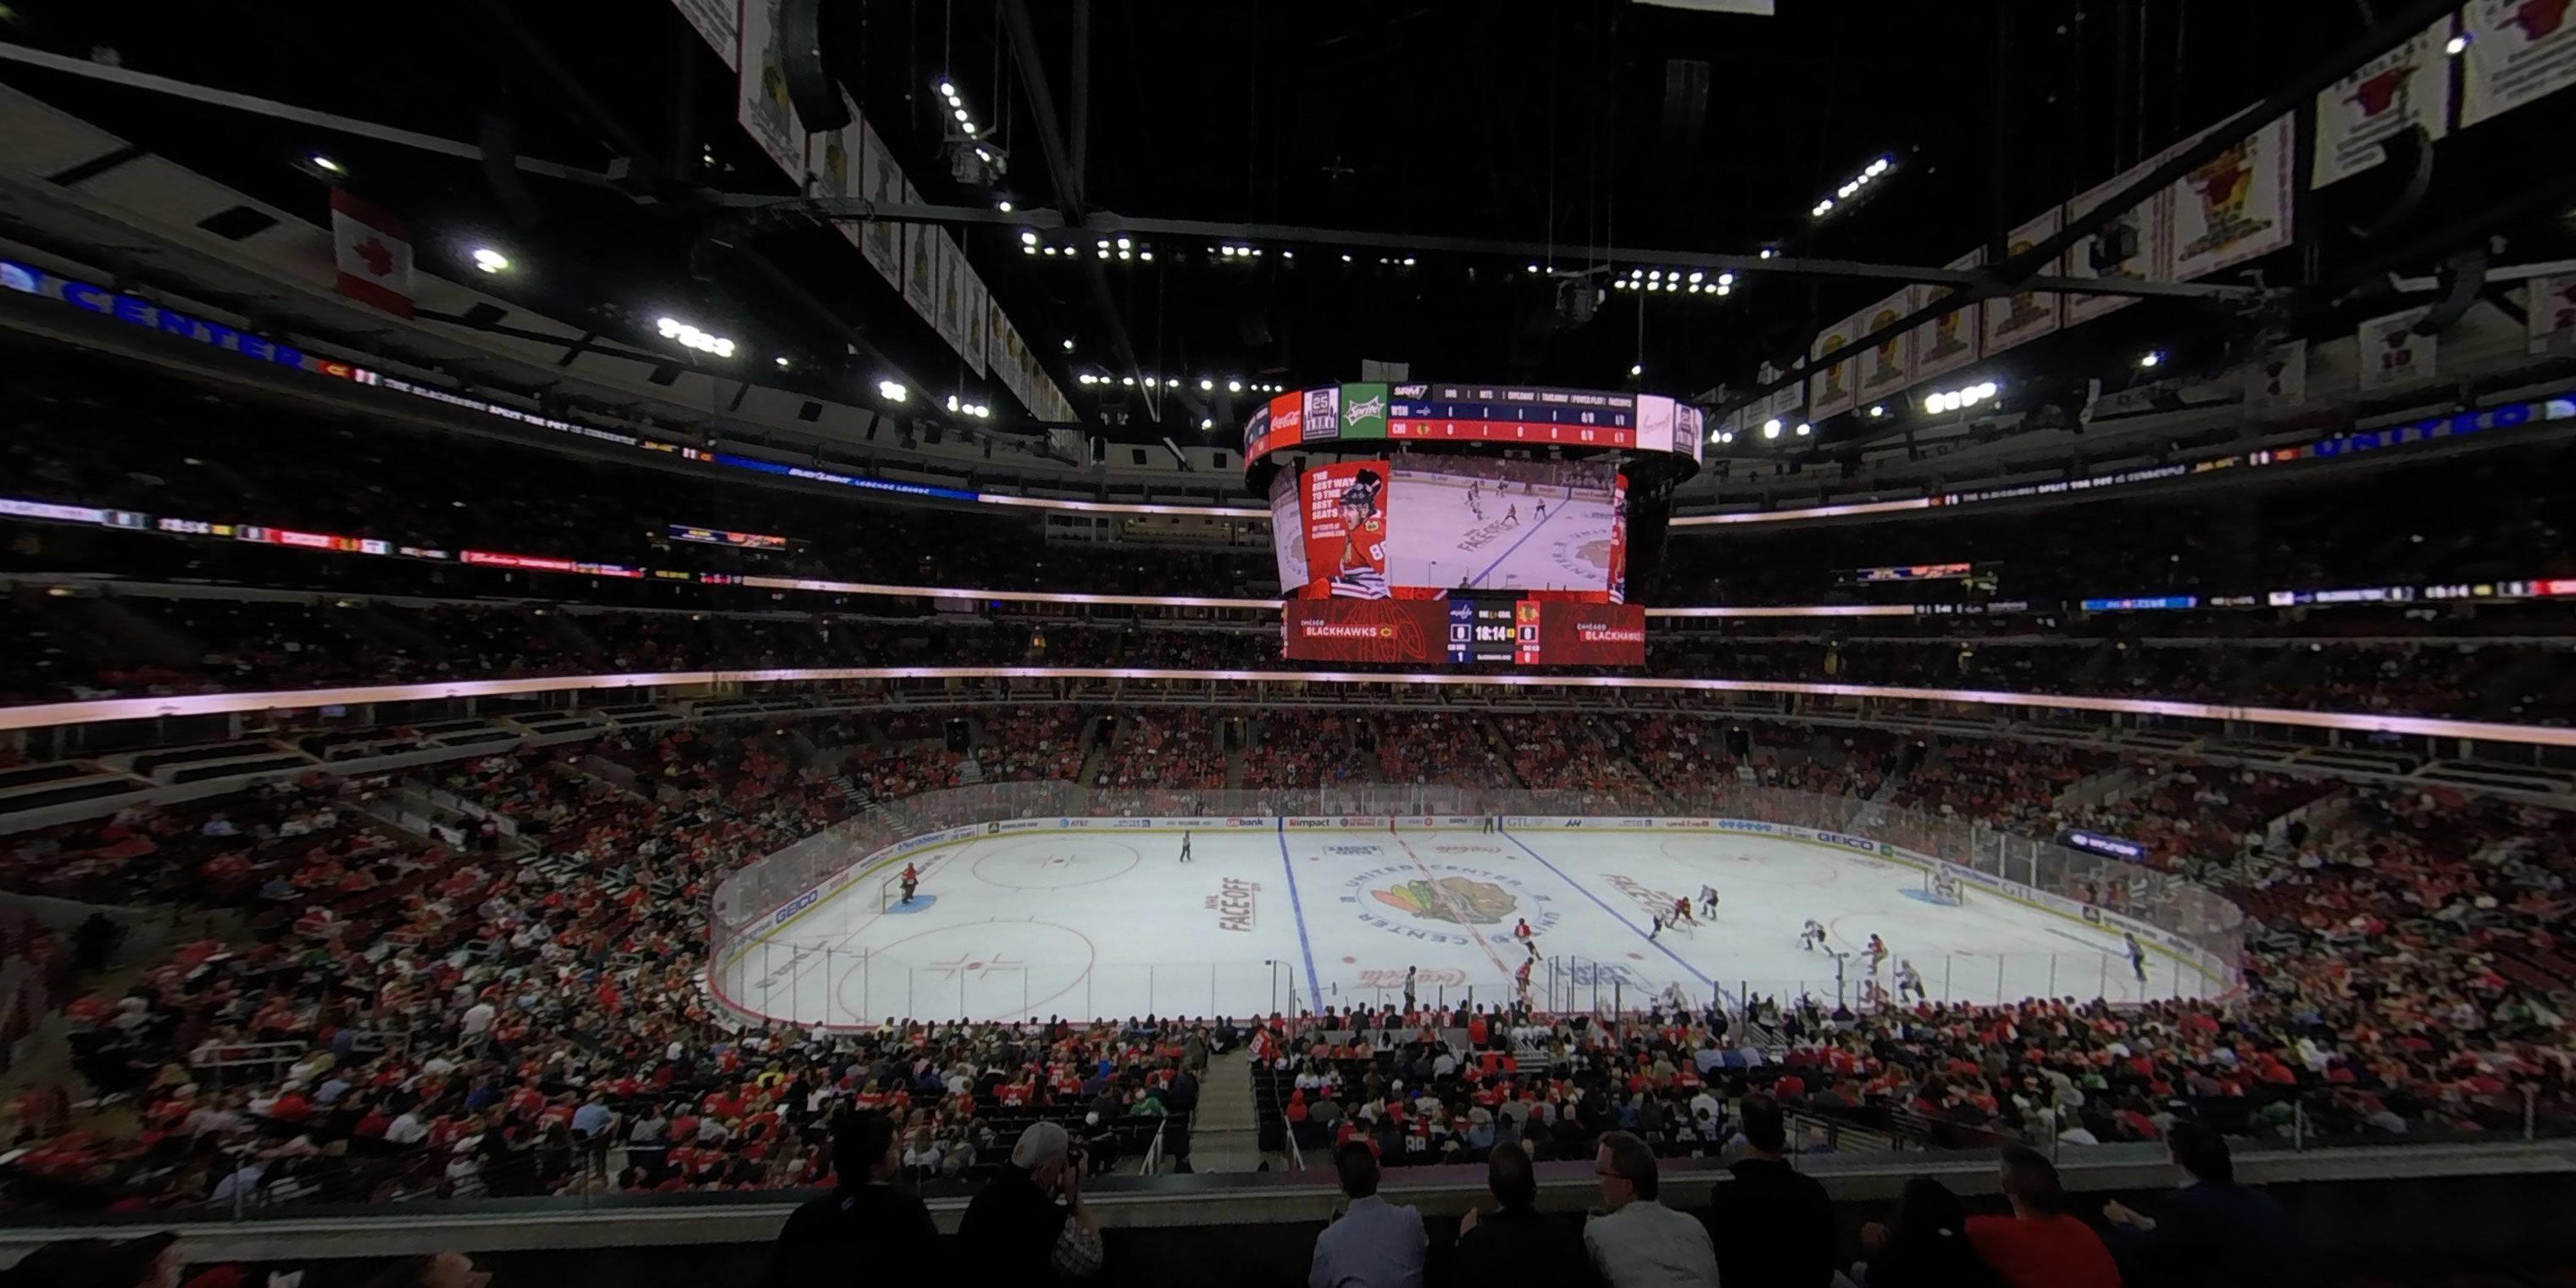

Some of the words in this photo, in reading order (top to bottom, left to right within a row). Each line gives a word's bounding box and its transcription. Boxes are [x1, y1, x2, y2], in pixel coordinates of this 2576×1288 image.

[61, 282, 303, 370] CENTER
[1313, 395, 1329, 409] 25
[1348, 402, 1380, 419] Sprite
[1391, 405, 1409, 417] WSH
[1271, 410, 1301, 431] Coca-Cola
[1392, 423, 1407, 435] CHI
[2313, 404, 2530, 457] UNITED
[1313, 470, 1329, 482] THE
[1312, 479, 1334, 491] BEST
[1334, 476, 1357, 488] WAY
[1313, 491, 1324, 501] TO
[1323, 489, 1341, 498] THE
[1312, 499, 1334, 510] BEST
[1312, 508, 1339, 520] SEATS
[1300, 619, 1325, 627] CHICAGO
[1576, 623, 1607, 631] CHICAGO
[1306, 627, 1378, 637] BLACKHAWKS
[1457, 626, 1465, 640] 0
[1524, 626, 1532, 641] 0
[1457, 652, 1463, 663] 1
[1070, 819, 1089, 828] AT&T
[1296, 818, 1330, 829] impact
[1817, 832, 1874, 852] GEICO
[1345, 864, 1414, 888] UNITED
[1430, 864, 1523, 887] CENTER
[774, 889, 818, 924] GEICO
[1219, 877, 1252, 932] FACE-OFF
[1359, 912, 1468, 947] CENTER
